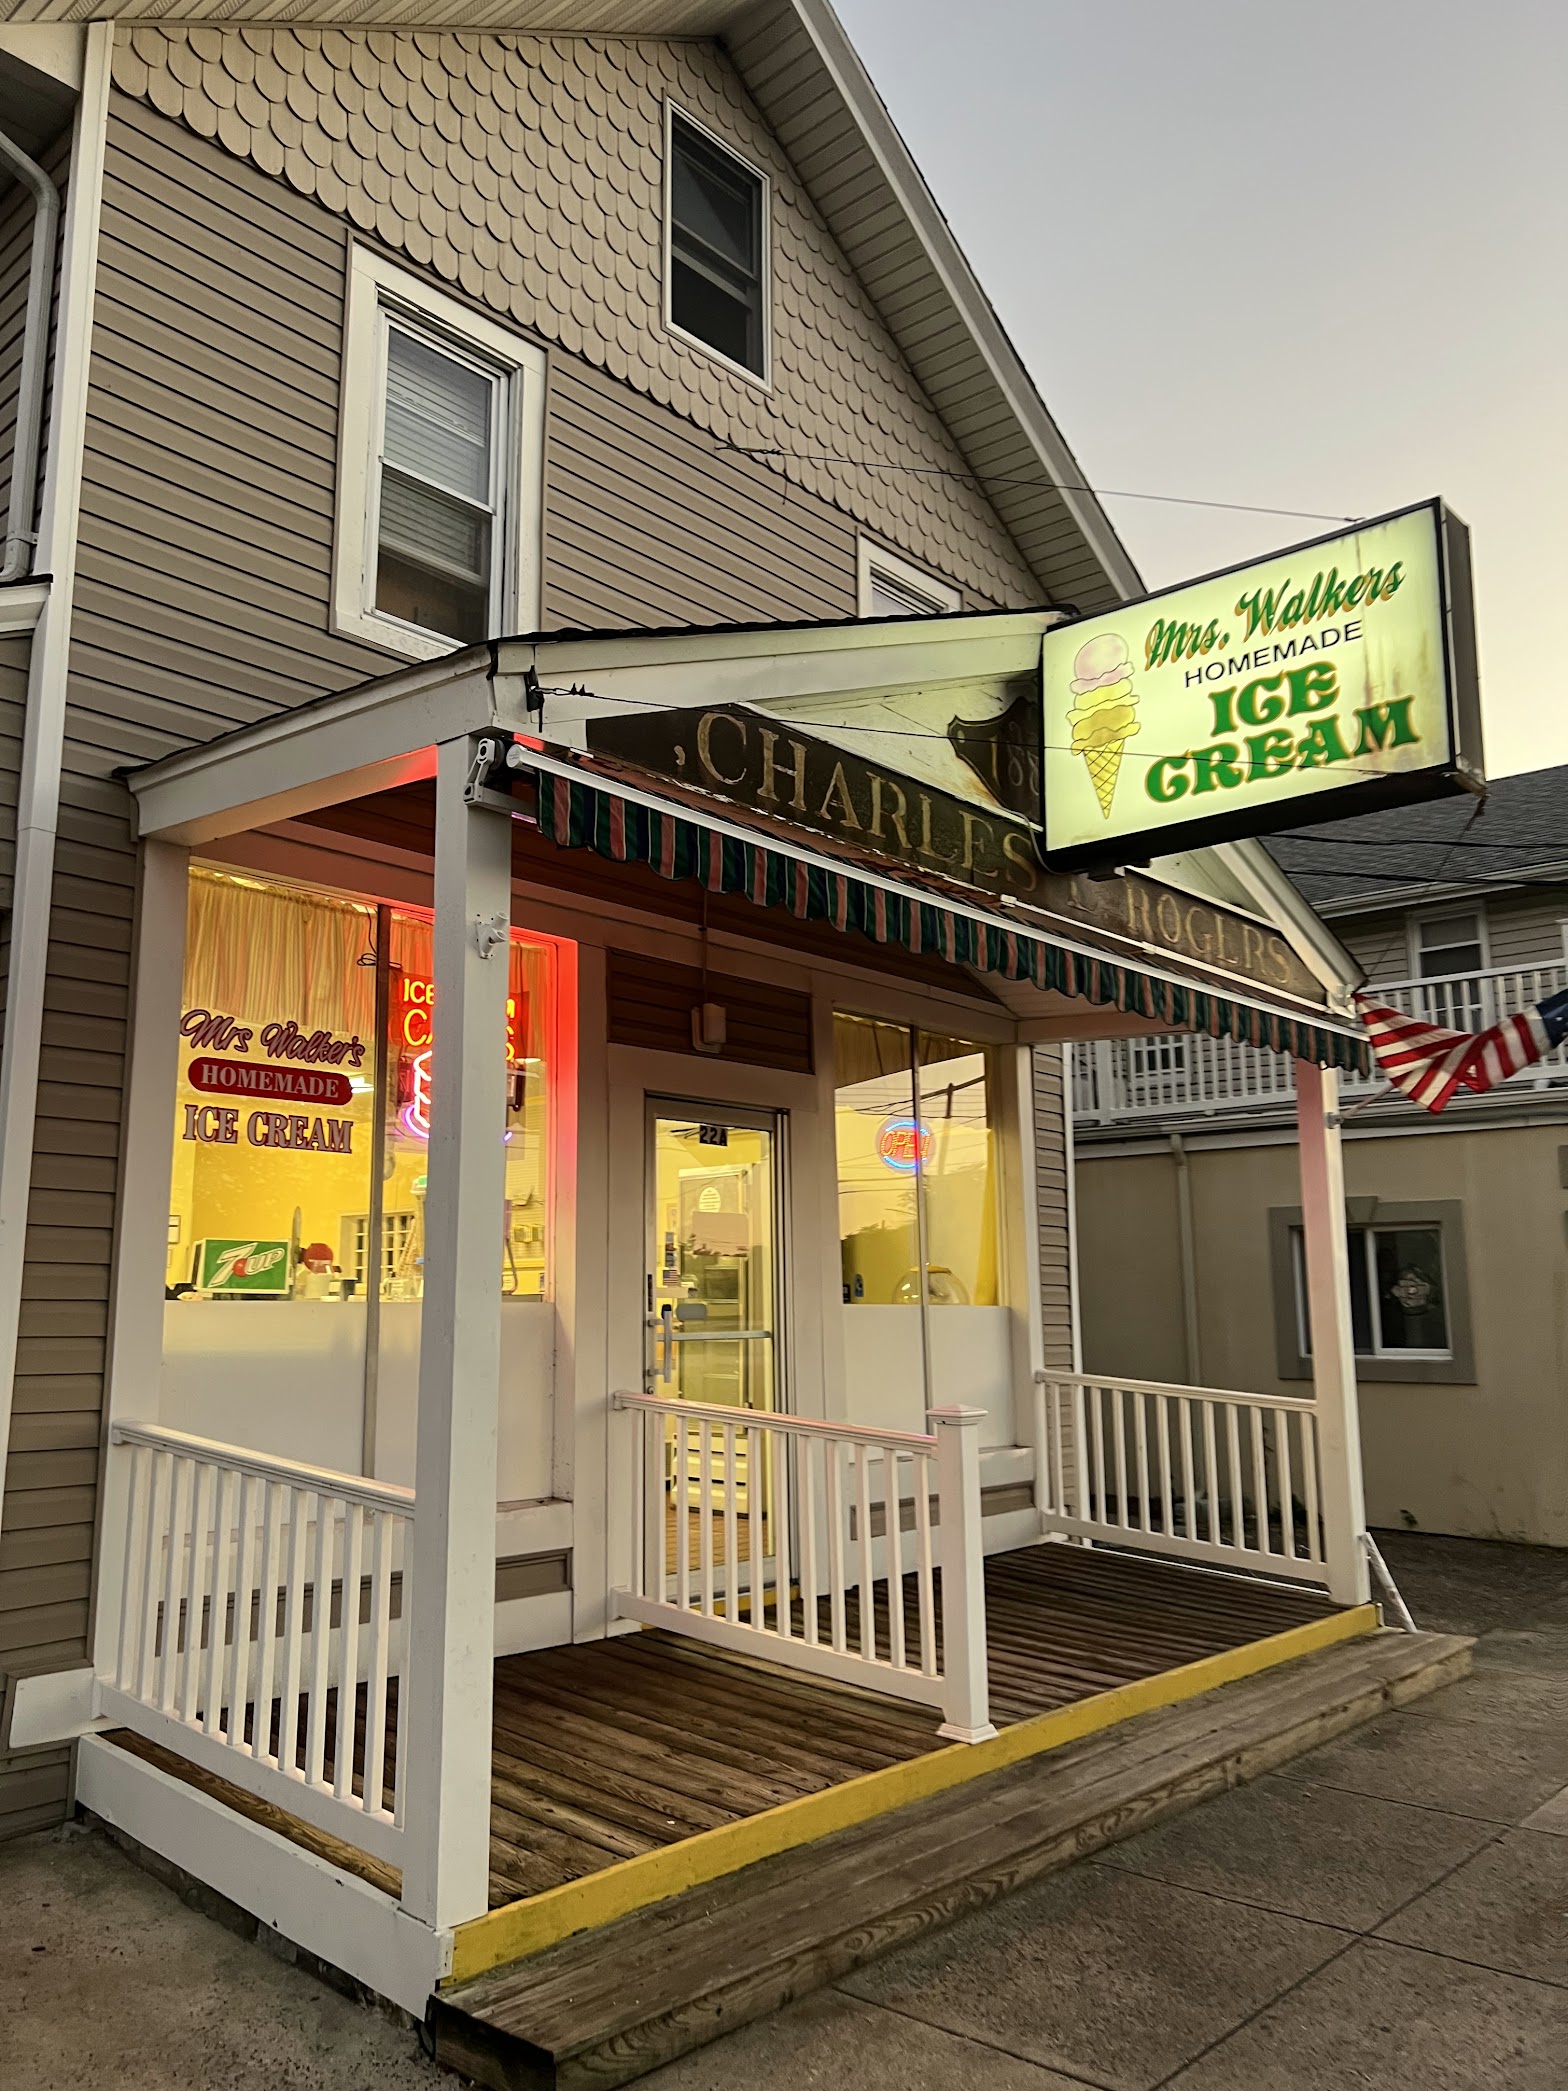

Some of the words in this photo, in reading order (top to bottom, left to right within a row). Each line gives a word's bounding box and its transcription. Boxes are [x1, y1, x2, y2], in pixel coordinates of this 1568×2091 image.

[1145, 618, 1230, 671] Mrs.
[1234, 560, 1406, 644] Walkers
[1185, 620, 1364, 688] HOMEMADE
[1209, 661, 1340, 737] ICE
[1145, 695, 1420, 804] CREAM
[697, 711, 1037, 892] CHARLES
[403, 978, 435, 1005] ICE
[180, 1009, 253, 1052] Mrs
[261, 1021, 366, 1067] Walker's
[201, 1064, 339, 1099] HOMEMADE
[183, 1104, 239, 1144] ICE
[247, 1111, 354, 1154] CREAM
[700, 1126, 728, 1146] 22A
